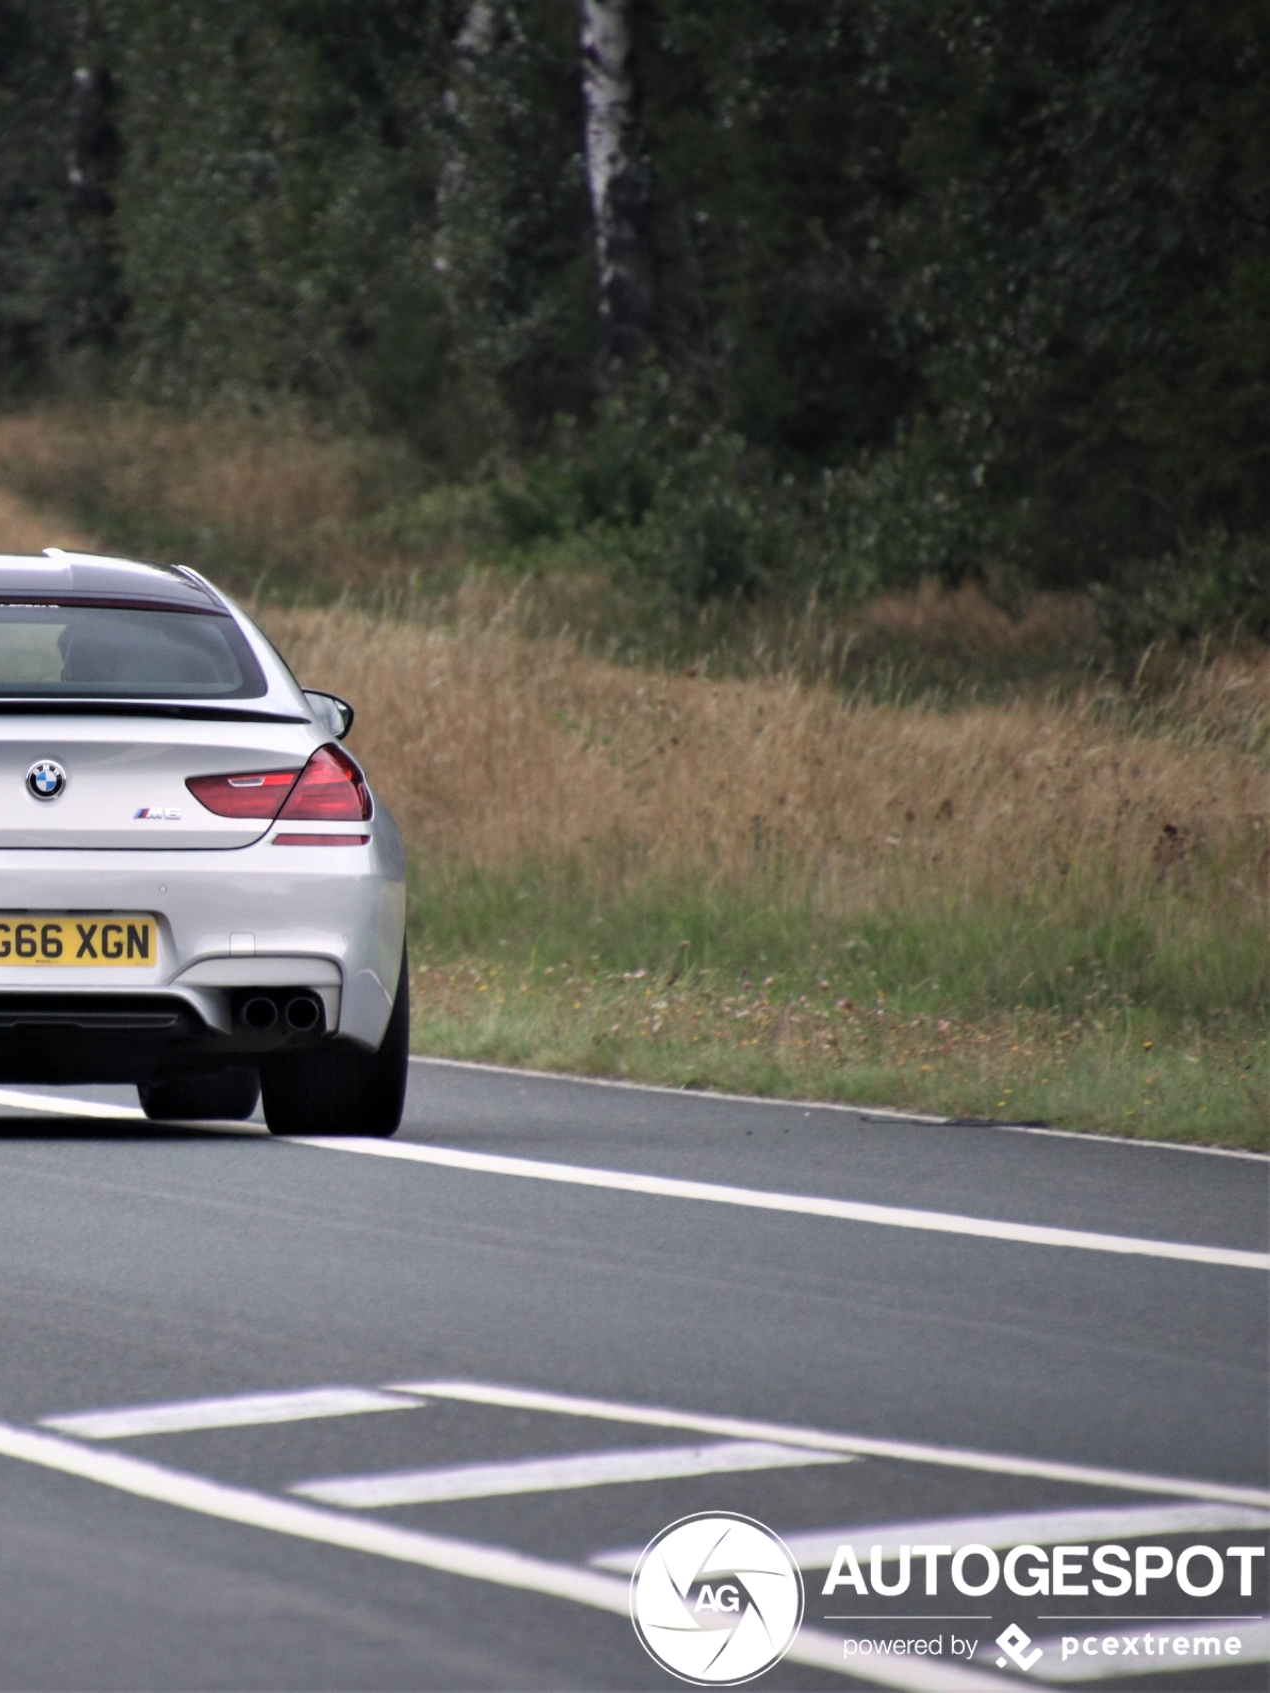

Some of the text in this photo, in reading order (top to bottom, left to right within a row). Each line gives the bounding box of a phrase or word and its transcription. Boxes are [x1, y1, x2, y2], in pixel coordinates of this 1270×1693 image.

[33, 764, 61, 776] BMW
[144, 807, 182, 820] M6
[76, 924, 149, 959] XGN
